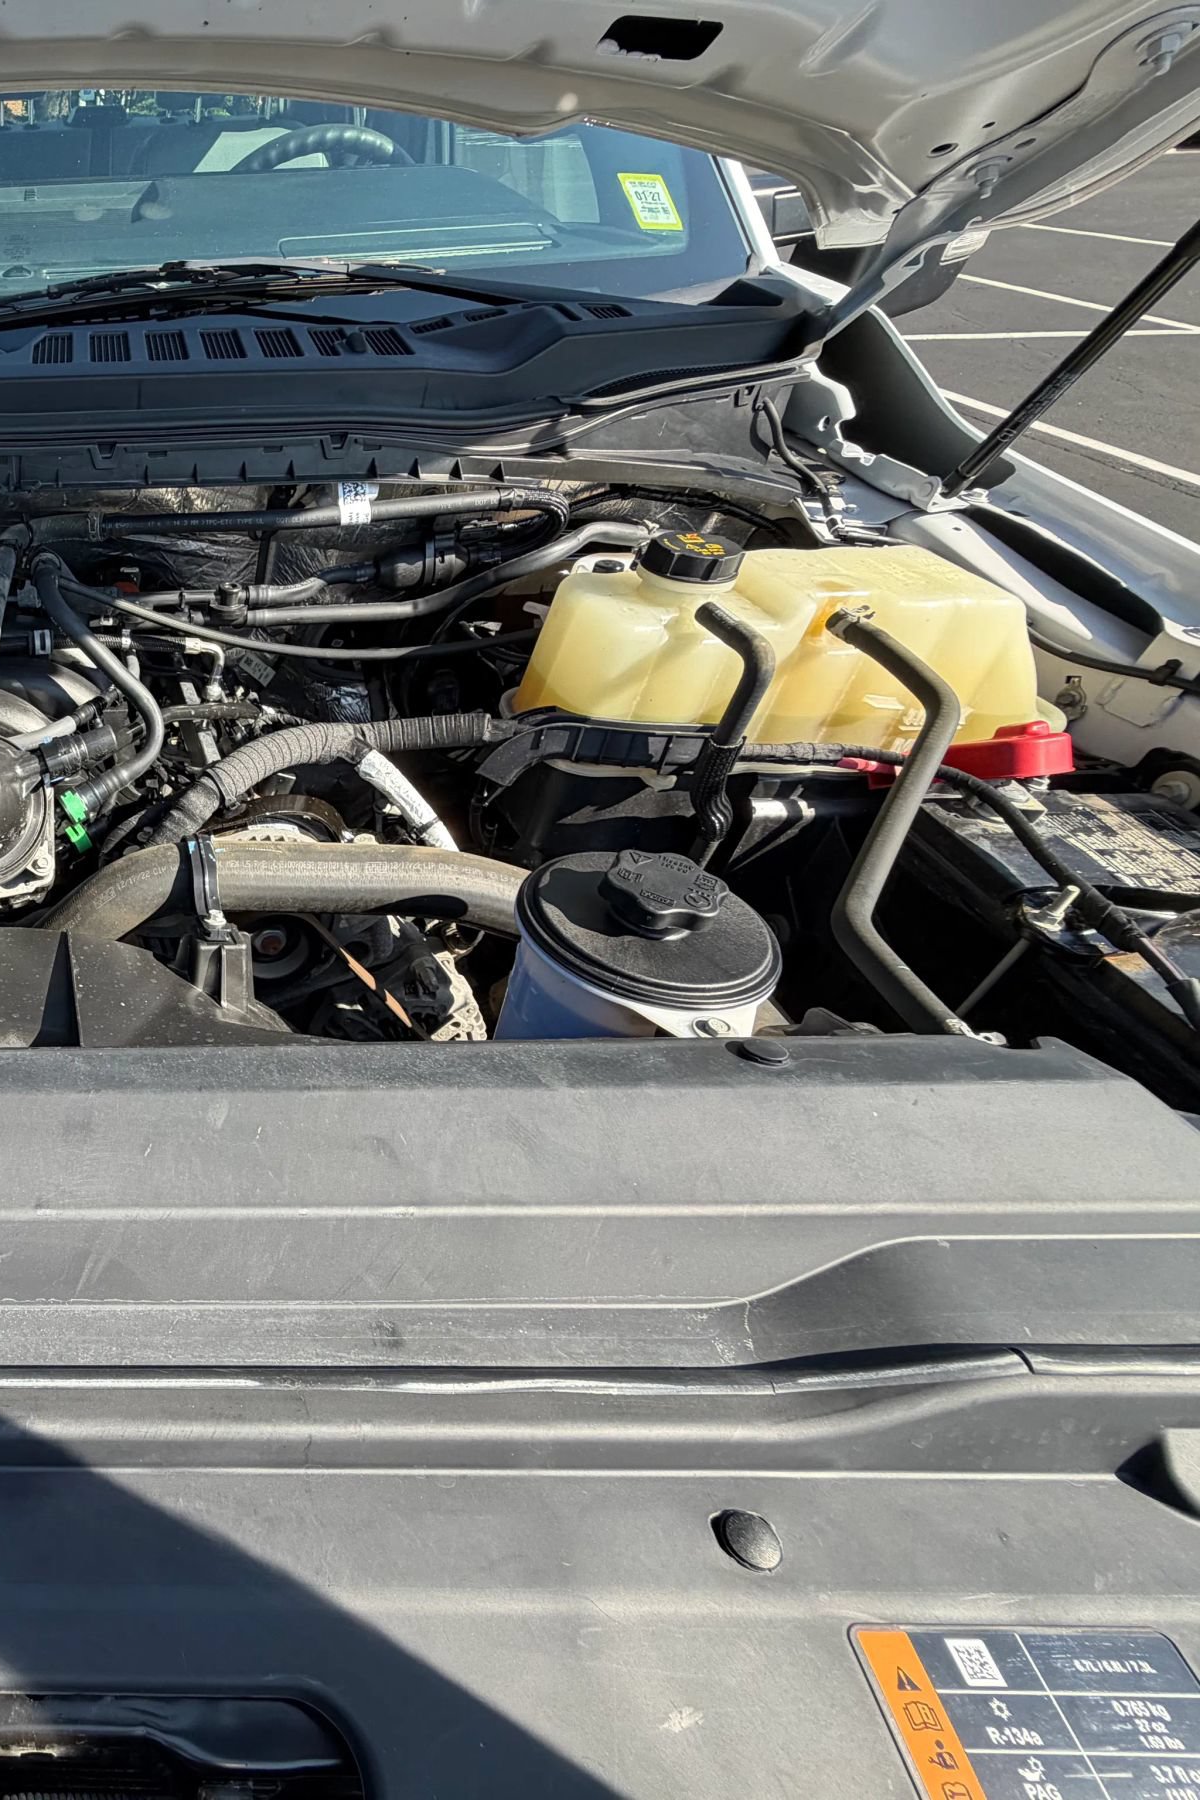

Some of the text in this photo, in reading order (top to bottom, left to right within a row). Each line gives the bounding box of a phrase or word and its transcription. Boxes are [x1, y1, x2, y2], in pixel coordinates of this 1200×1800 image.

[1111, 1700, 1173, 1722] 0.765 kg
[1134, 1718, 1170, 1734] 27 oz
[985, 1726, 1045, 1746] R-134a
[1161, 1735, 1187, 1751] lbs
[1149, 1765, 1177, 1784] 3.7
[1022, 1783, 1063, 1800] PAG
